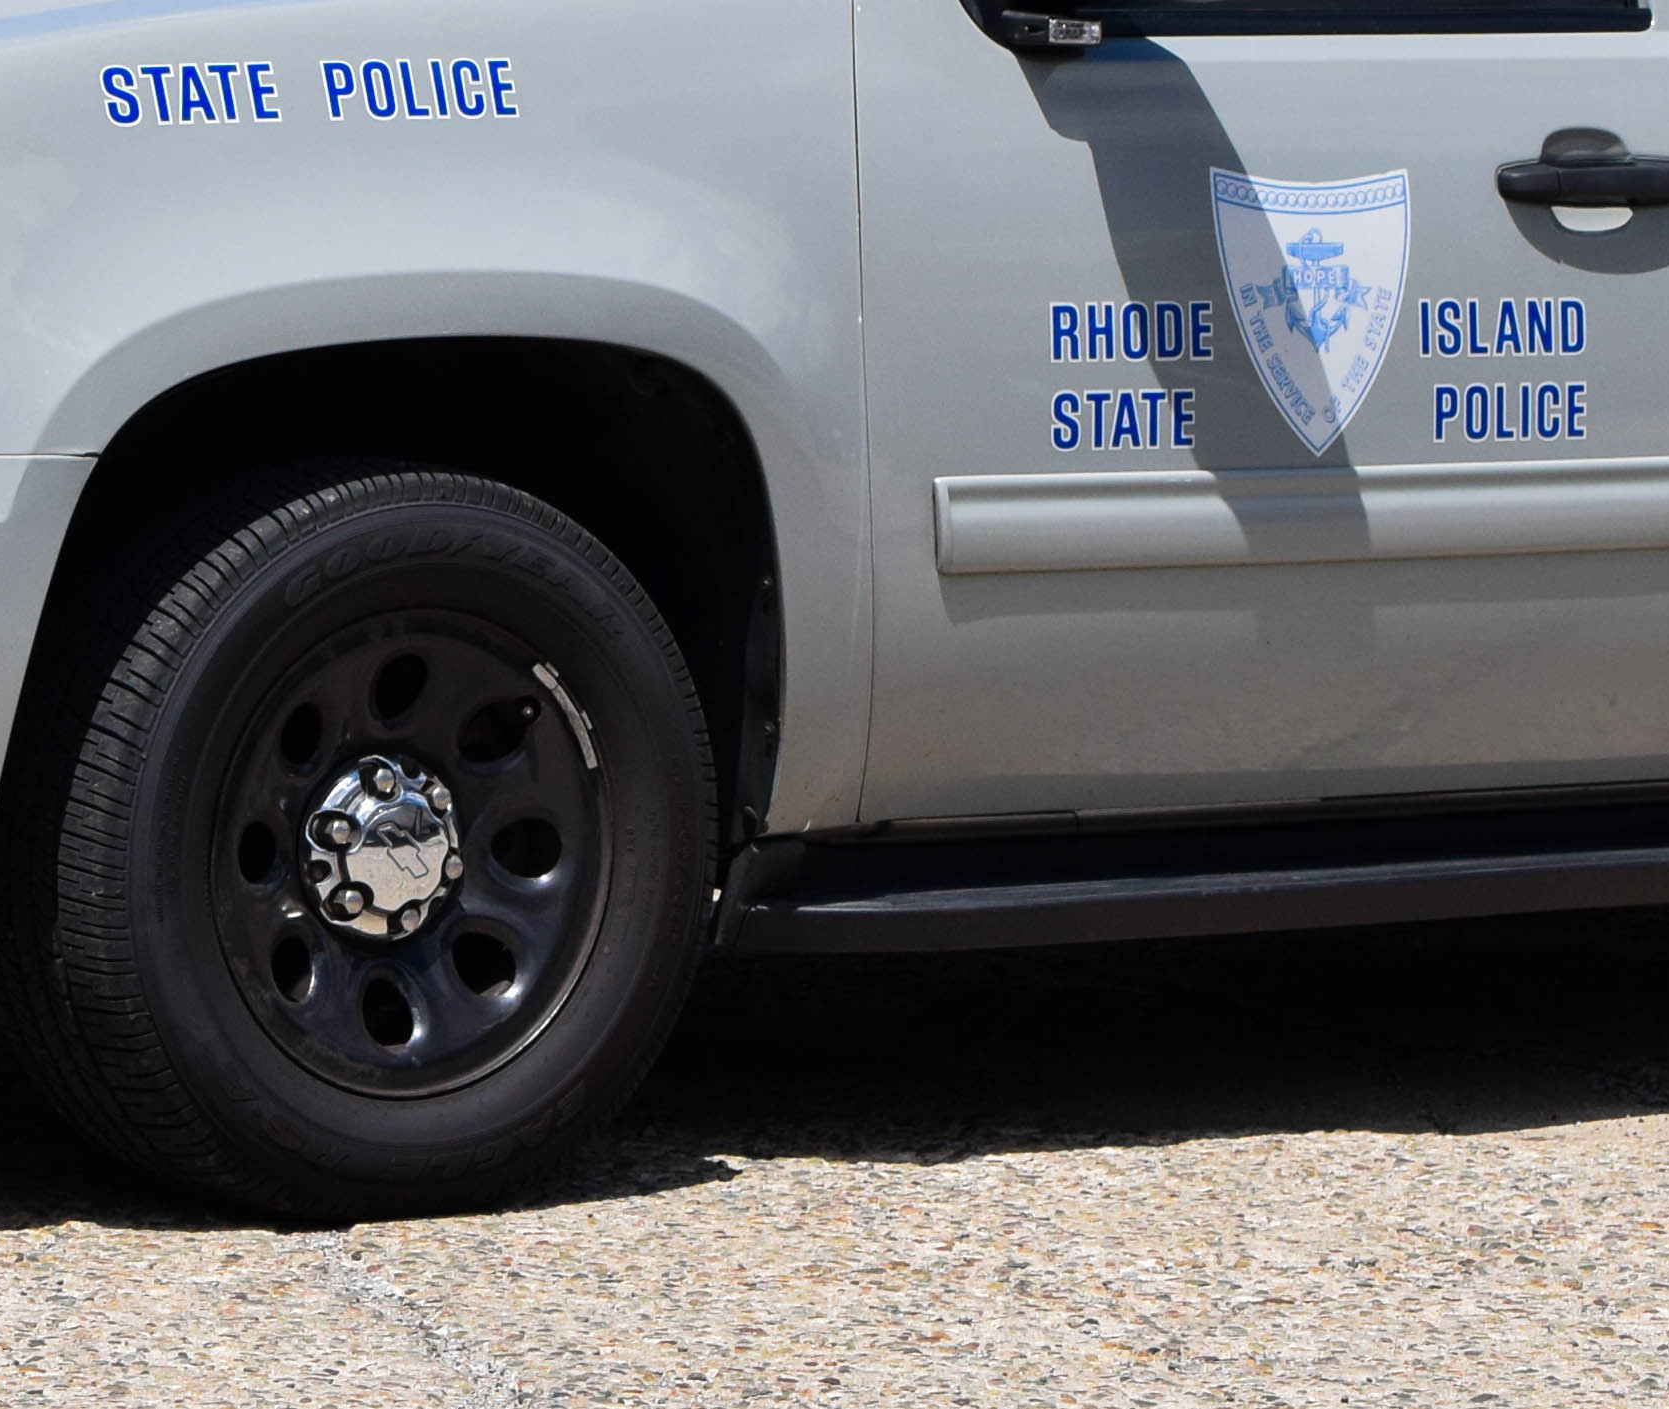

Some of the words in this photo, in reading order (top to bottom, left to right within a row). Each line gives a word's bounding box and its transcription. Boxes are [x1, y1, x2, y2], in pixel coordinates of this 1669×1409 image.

[100, 62, 282, 127] STATE
[320, 58, 520, 121] POLICE
[1293, 269, 1337, 284] HOPE
[1050, 302, 1214, 362] RHODE
[1419, 298, 1586, 357] ISLAND
[1051, 389, 1195, 451] STATE
[1434, 382, 1587, 441] POLICE
[1265, 352, 1317, 427] SERVICE
